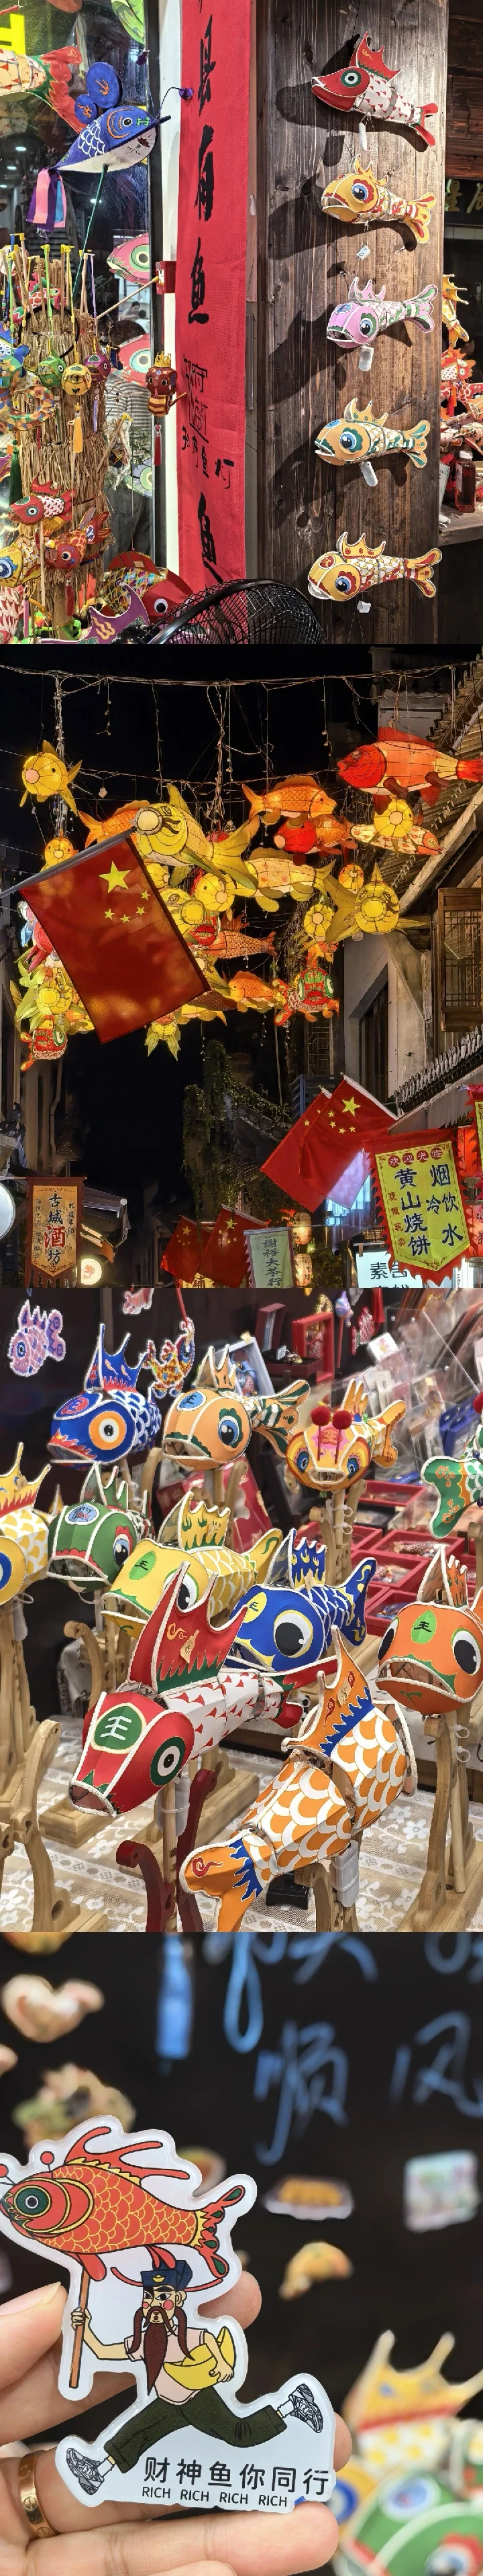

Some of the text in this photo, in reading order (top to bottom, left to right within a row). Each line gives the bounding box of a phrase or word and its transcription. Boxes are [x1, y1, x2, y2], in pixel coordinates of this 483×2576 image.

[389, 1148, 443, 1167] 欢迎光临
[394, 1167, 431, 1256] 黄山烧饼
[426, 1164, 464, 1246] 烟 冷饮 水
[44, 1193, 66, 1265] 古城酒坊
[135, 1560, 149, 1570] 王
[413, 1621, 432, 1633] 王
[100, 1715, 133, 1741] 王
[143, 2456, 330, 2496] 财神鱼你同行
[142, 2486, 288, 2508] RICH RICH RICH RICH
